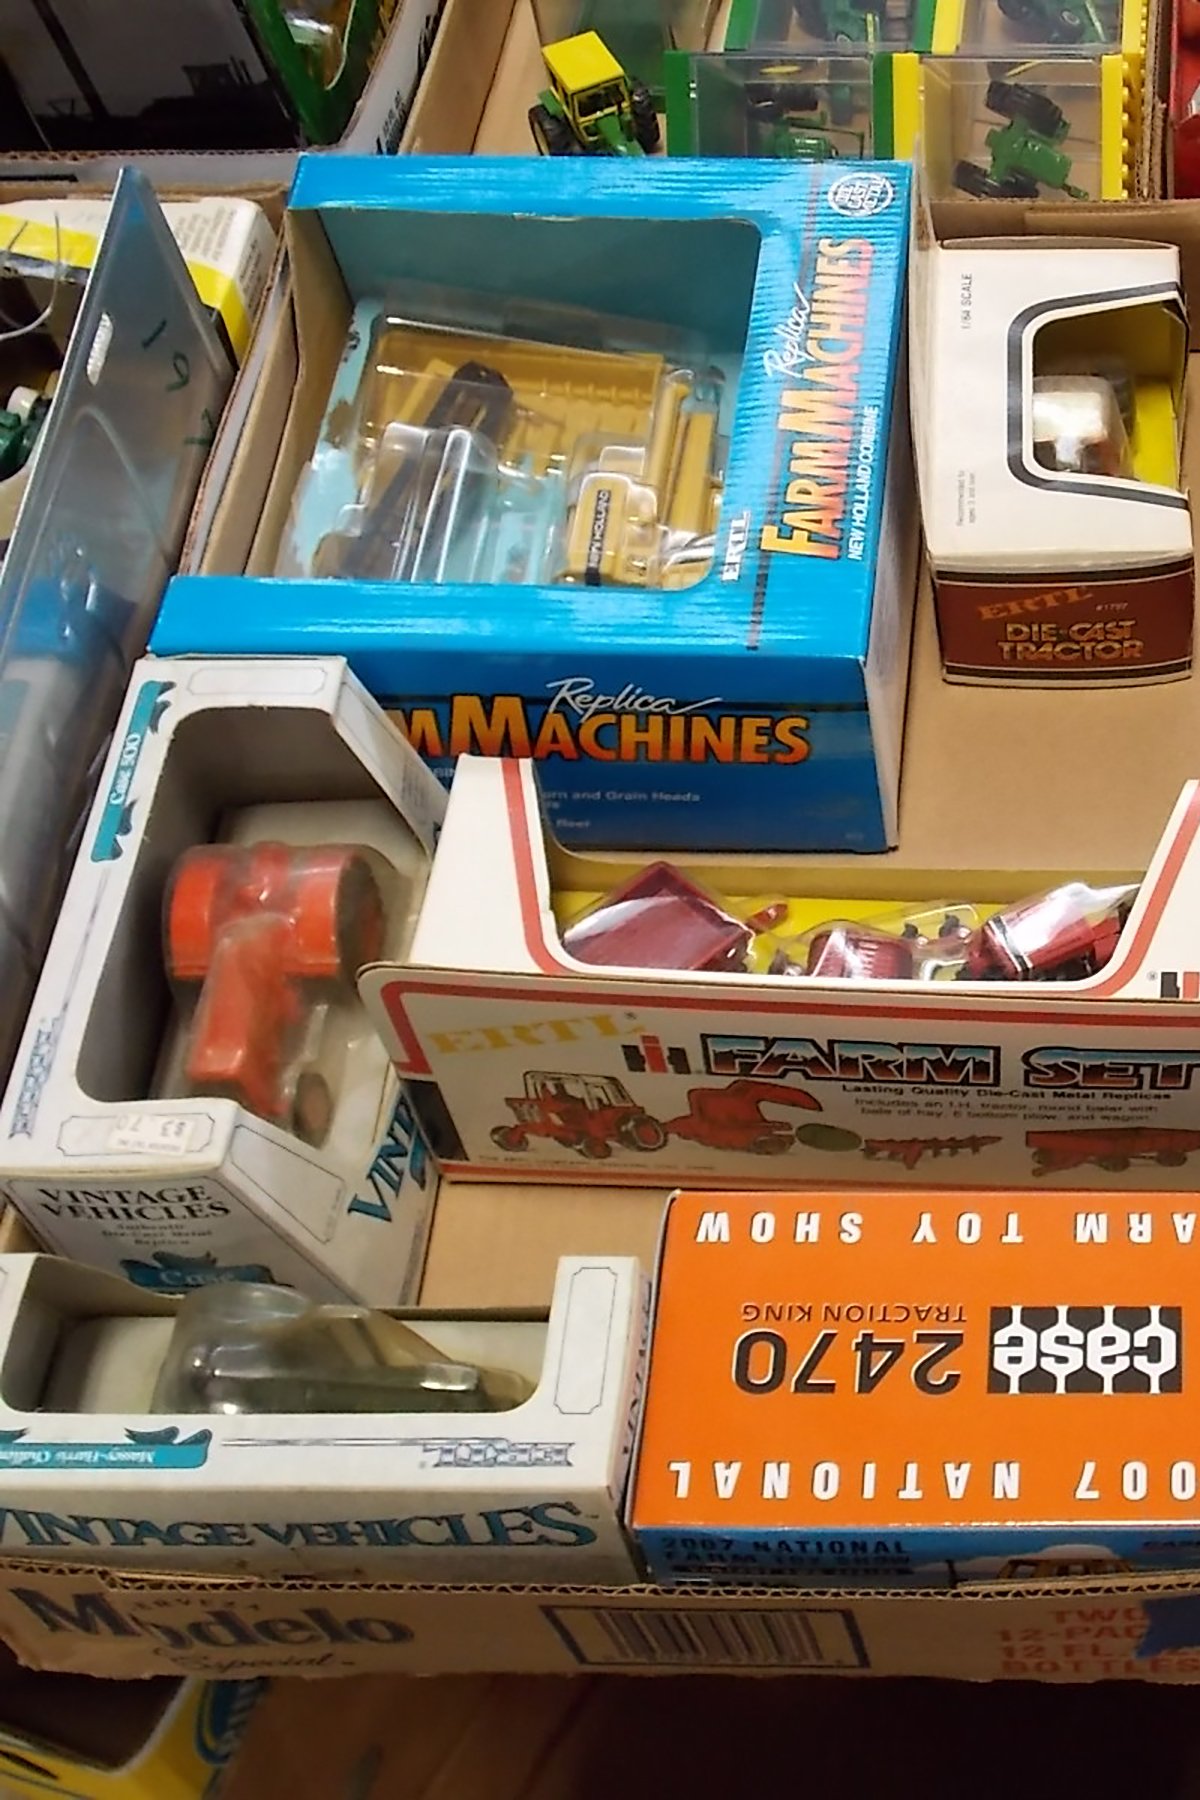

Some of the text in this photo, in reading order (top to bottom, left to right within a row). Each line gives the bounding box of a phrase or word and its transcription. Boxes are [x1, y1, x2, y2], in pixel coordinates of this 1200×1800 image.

[961, 273, 972, 307] SCALE
[764, 281, 812, 379] Replica
[760, 235, 875, 561] FARM MACHINES
[846, 404, 880, 561] NEW HOLLAND COMBINE
[721, 511, 750, 582] ERTL
[997, 640, 1145, 661] TRACTOR
[545, 677, 722, 723] Replica
[449, 695, 811, 765] MACHINES
[543, 791, 568, 801] orn
[427, 1012, 645, 1054] ERTL
[700, 1032, 1001, 1088] FARM
[841, 1084, 1172, 1101] Lasting Quality Die-Cast Metal Replicas
[348, 1090, 417, 1225] VINT
[38, 1184, 213, 1205] VINTAGE
[41, 1200, 232, 1221] VEHICLES
[695, 1211, 863, 1244] SHOW
[913, 1211, 1024, 1244] TOY
[741, 1303, 968, 1323] TRACTION KING
[731, 1331, 966, 1395] 2470
[988, 1305, 1183, 1395] case
[668, 1461, 1021, 1501] NATIONAL
[249, 1501, 599, 1548] VEHICLES
[661, 1536, 907, 1555] 2007 NATIONAL
[9, 1586, 416, 1652] Modelo
[1054, 1607, 1148, 1624] TWO
[1000, 1626, 1148, 1643] 12-PAC
[1001, 1644, 1045, 1659] 12
[1001, 1657, 1200, 1674] BOTTLES
